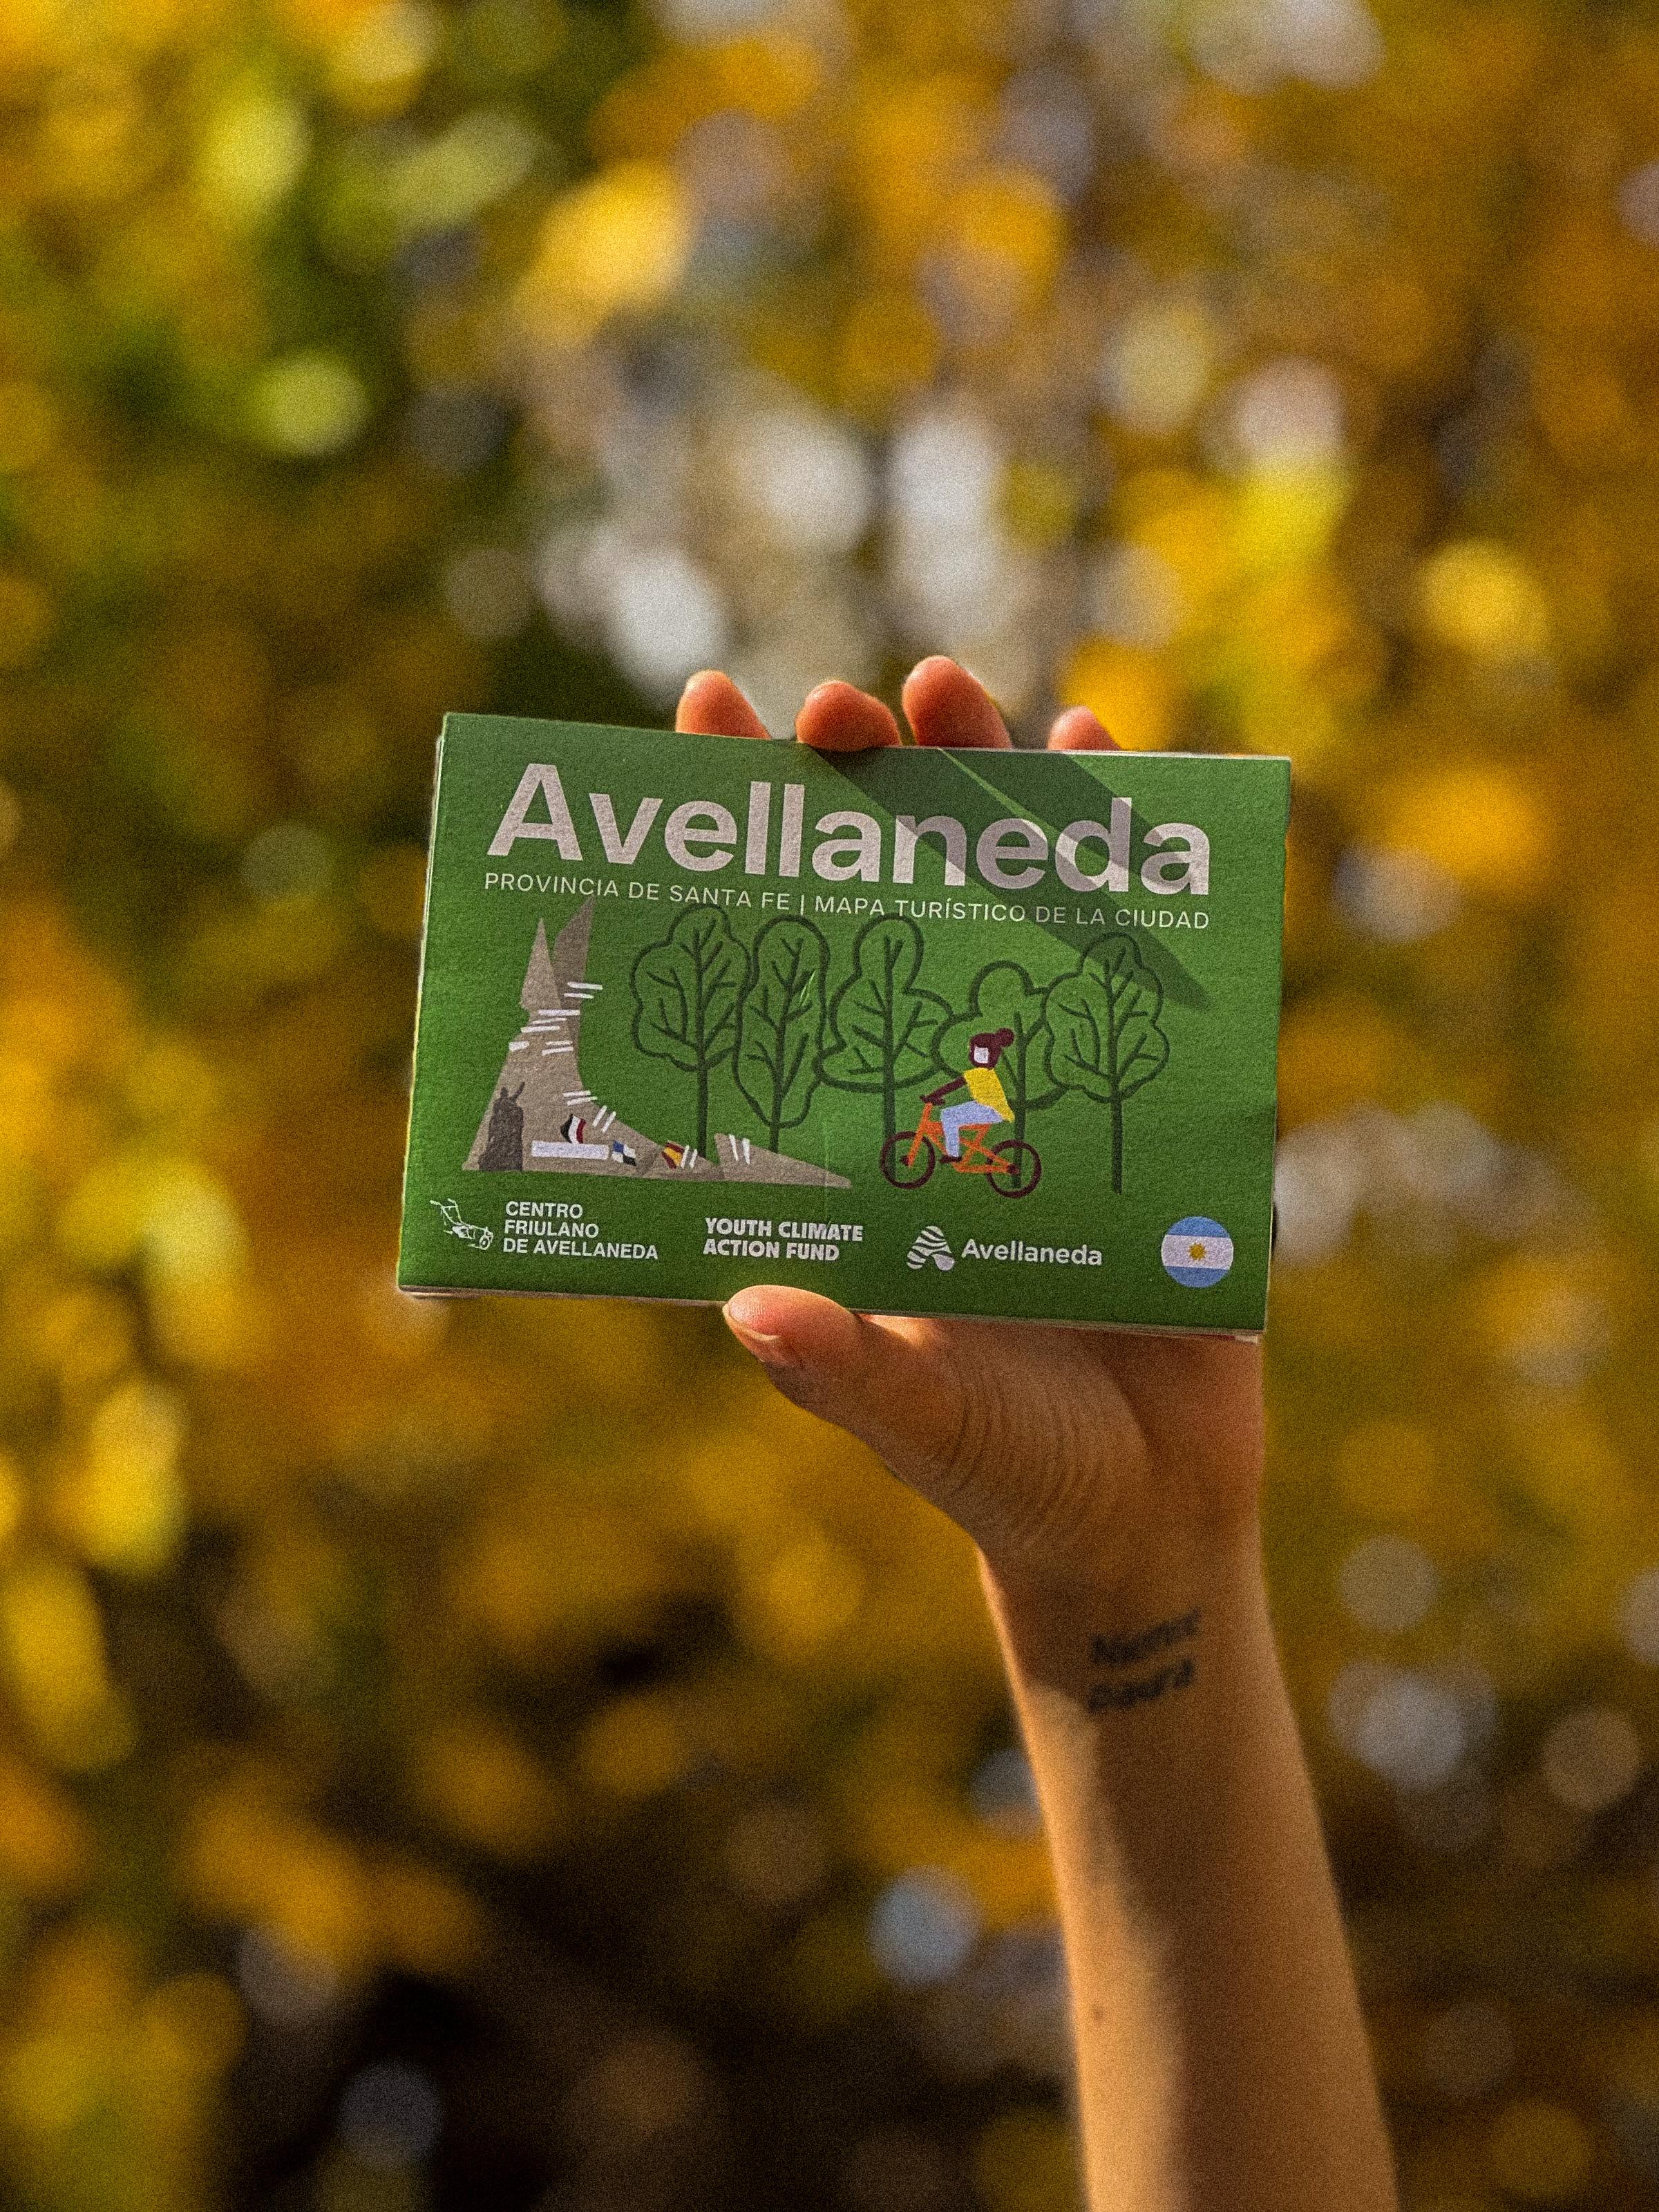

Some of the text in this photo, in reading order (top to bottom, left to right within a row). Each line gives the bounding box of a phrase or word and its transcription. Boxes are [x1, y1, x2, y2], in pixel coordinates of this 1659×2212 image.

[486, 763, 1210, 896] Avellaneda
[485, 872, 618, 897] PROVINCIA
[628, 882, 660, 900] DE
[670, 885, 751, 907] SANTA
[761, 892, 790, 910] FE
[815, 896, 884, 916] MAPA
[895, 898, 1025, 923] TURÍSTICO
[1036, 906, 1065, 924] DE
[1077, 907, 1105, 925] LA
[1116, 909, 1209, 929] CIUDAD
[505, 1200, 583, 1219] CENTRO
[504, 1220, 599, 1238] FRIULANO
[705, 1217, 863, 1242] YOUTH CLIMATE
[503, 1238, 658, 1260] DE AVELLANEDA
[703, 1238, 840, 1261] ACTION FUND
[961, 1239, 1103, 1266] Avellaneda
